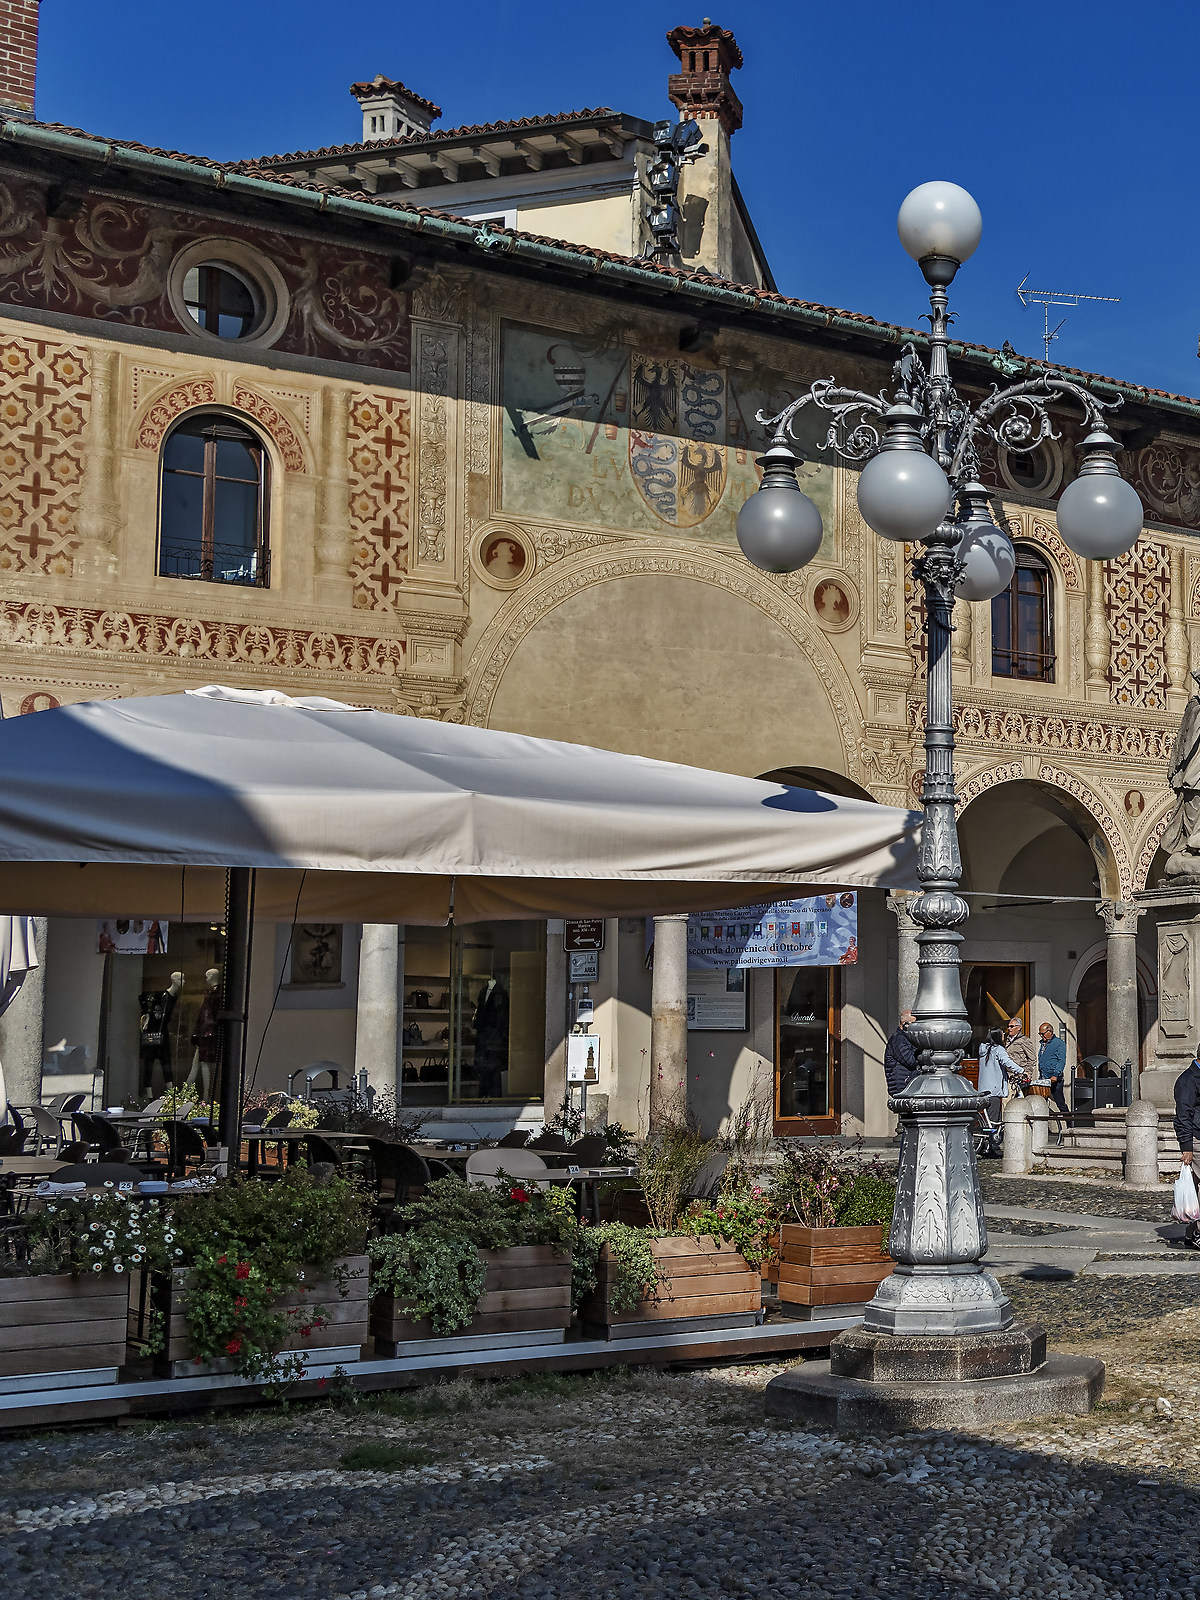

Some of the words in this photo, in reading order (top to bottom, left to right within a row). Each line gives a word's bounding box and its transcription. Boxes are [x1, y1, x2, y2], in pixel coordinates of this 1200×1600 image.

[688, 945, 723, 955] seconda
[725, 943, 767, 954] domenica
[769, 943, 779, 952] di
[780, 942, 813, 952] Ottobre
[713, 956, 789, 966] www.paliodivigevano.it
[790, 1012, 816, 1022] Ducale
